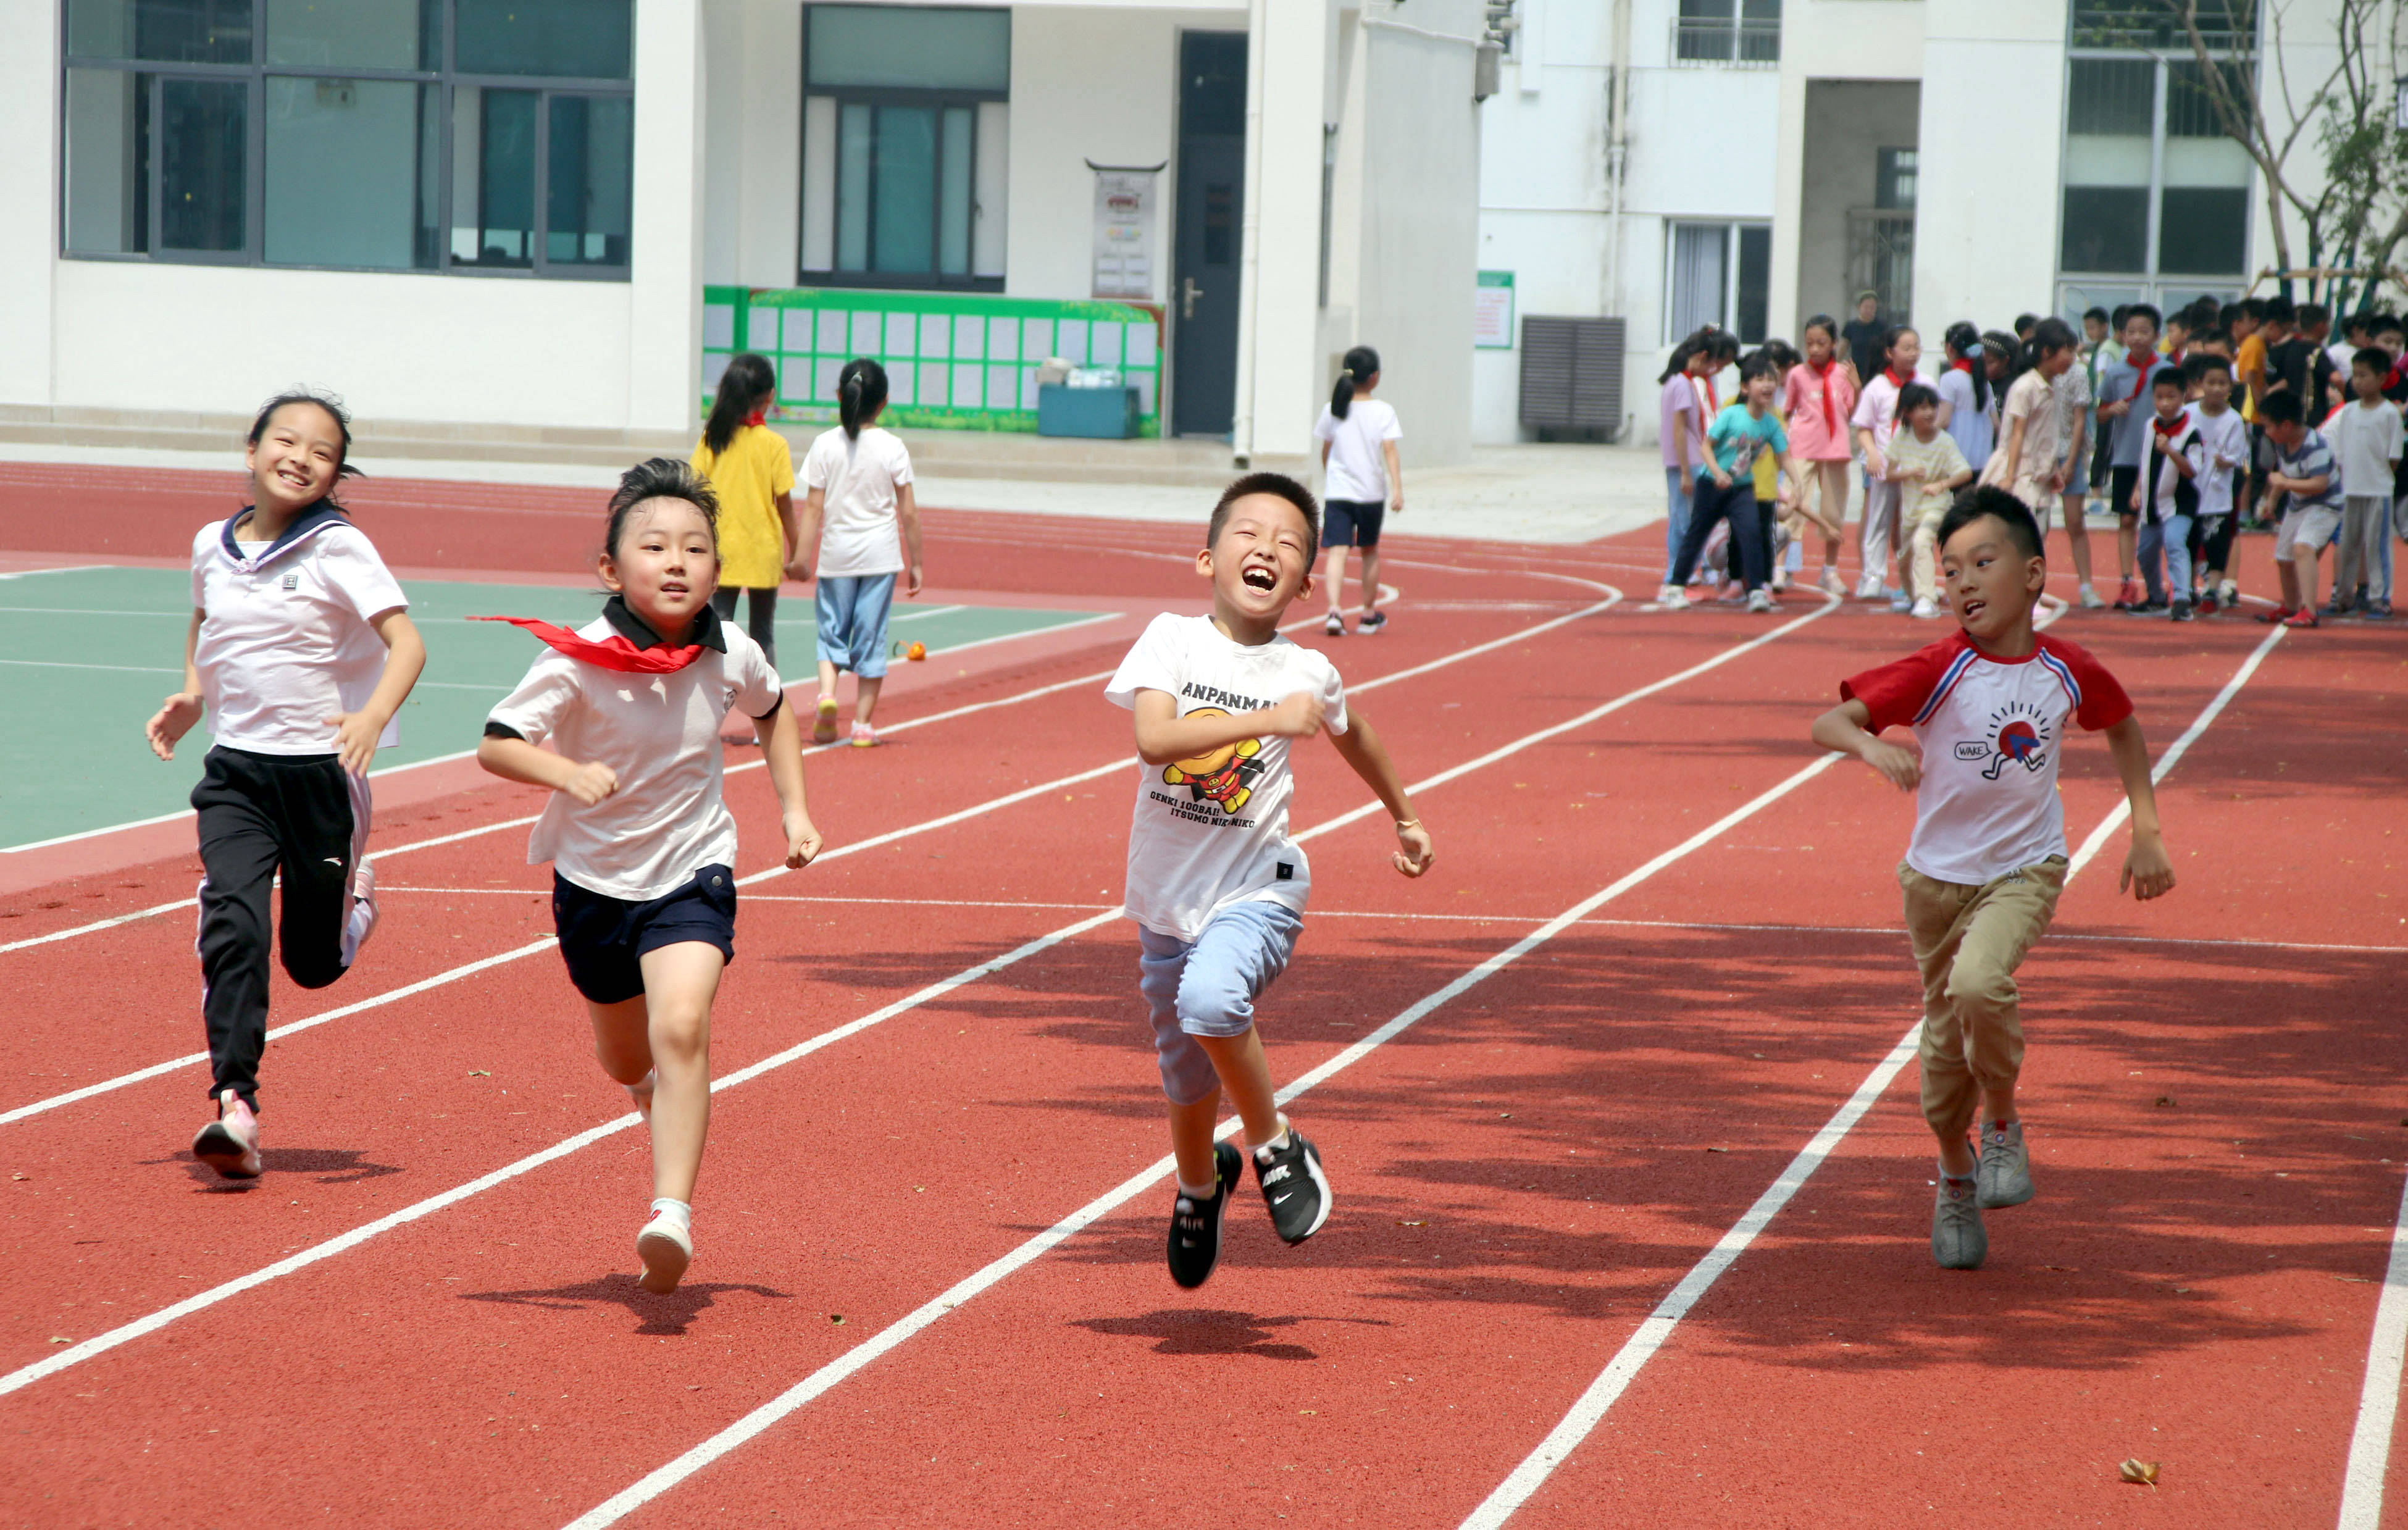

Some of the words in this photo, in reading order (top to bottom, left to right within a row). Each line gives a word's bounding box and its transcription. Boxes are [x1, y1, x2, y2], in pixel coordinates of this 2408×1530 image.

[1959, 746, 1983, 756] WAKE
[1150, 791, 1178, 806] GENKI
[1181, 801, 1220, 816] 100BAI!
[1171, 808, 1208, 824] ITSUMO
[1211, 817, 1231, 827] NIK
[1231, 818, 1255, 828] NIKO
[1262, 1164, 1292, 1188] AIR
